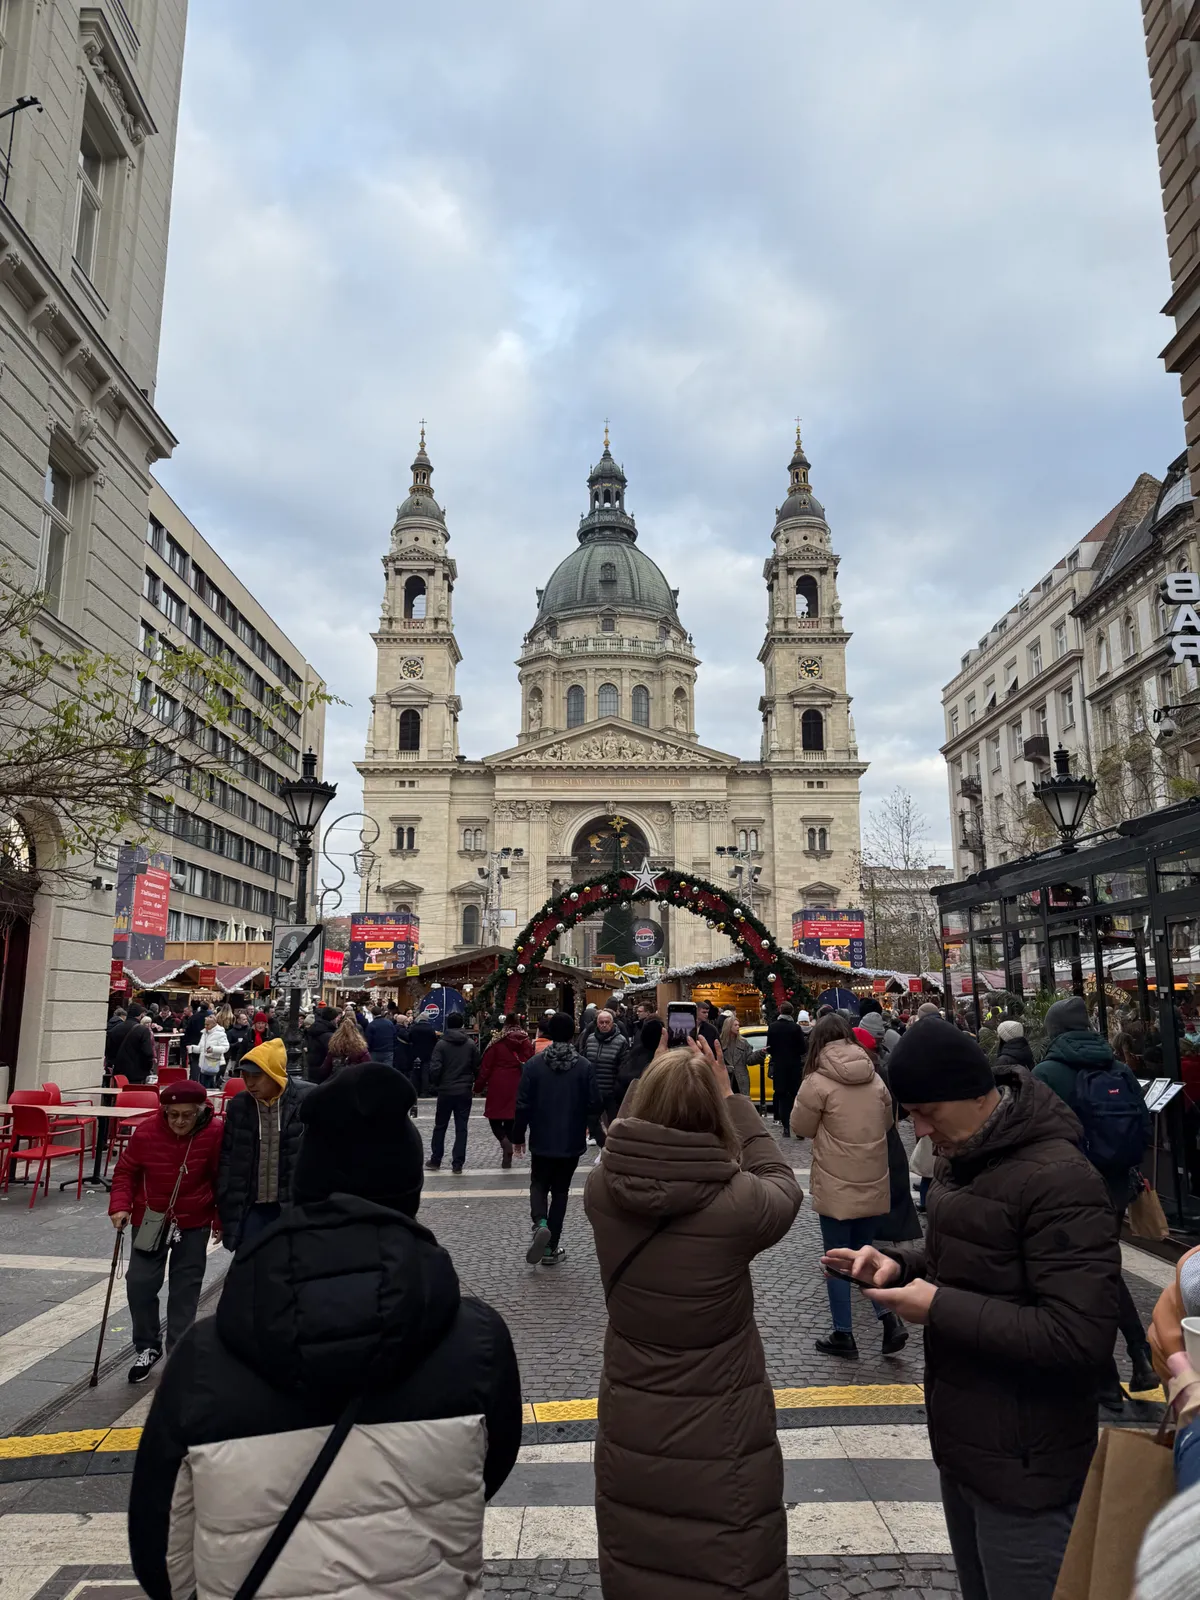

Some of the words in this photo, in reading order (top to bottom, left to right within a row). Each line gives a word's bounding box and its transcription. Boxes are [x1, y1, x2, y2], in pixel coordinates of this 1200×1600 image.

[563, 778, 583, 786] SUM
[587, 778, 604, 786] VIA
[607, 778, 644, 786] VERITAS
[662, 778, 681, 786] VITA
